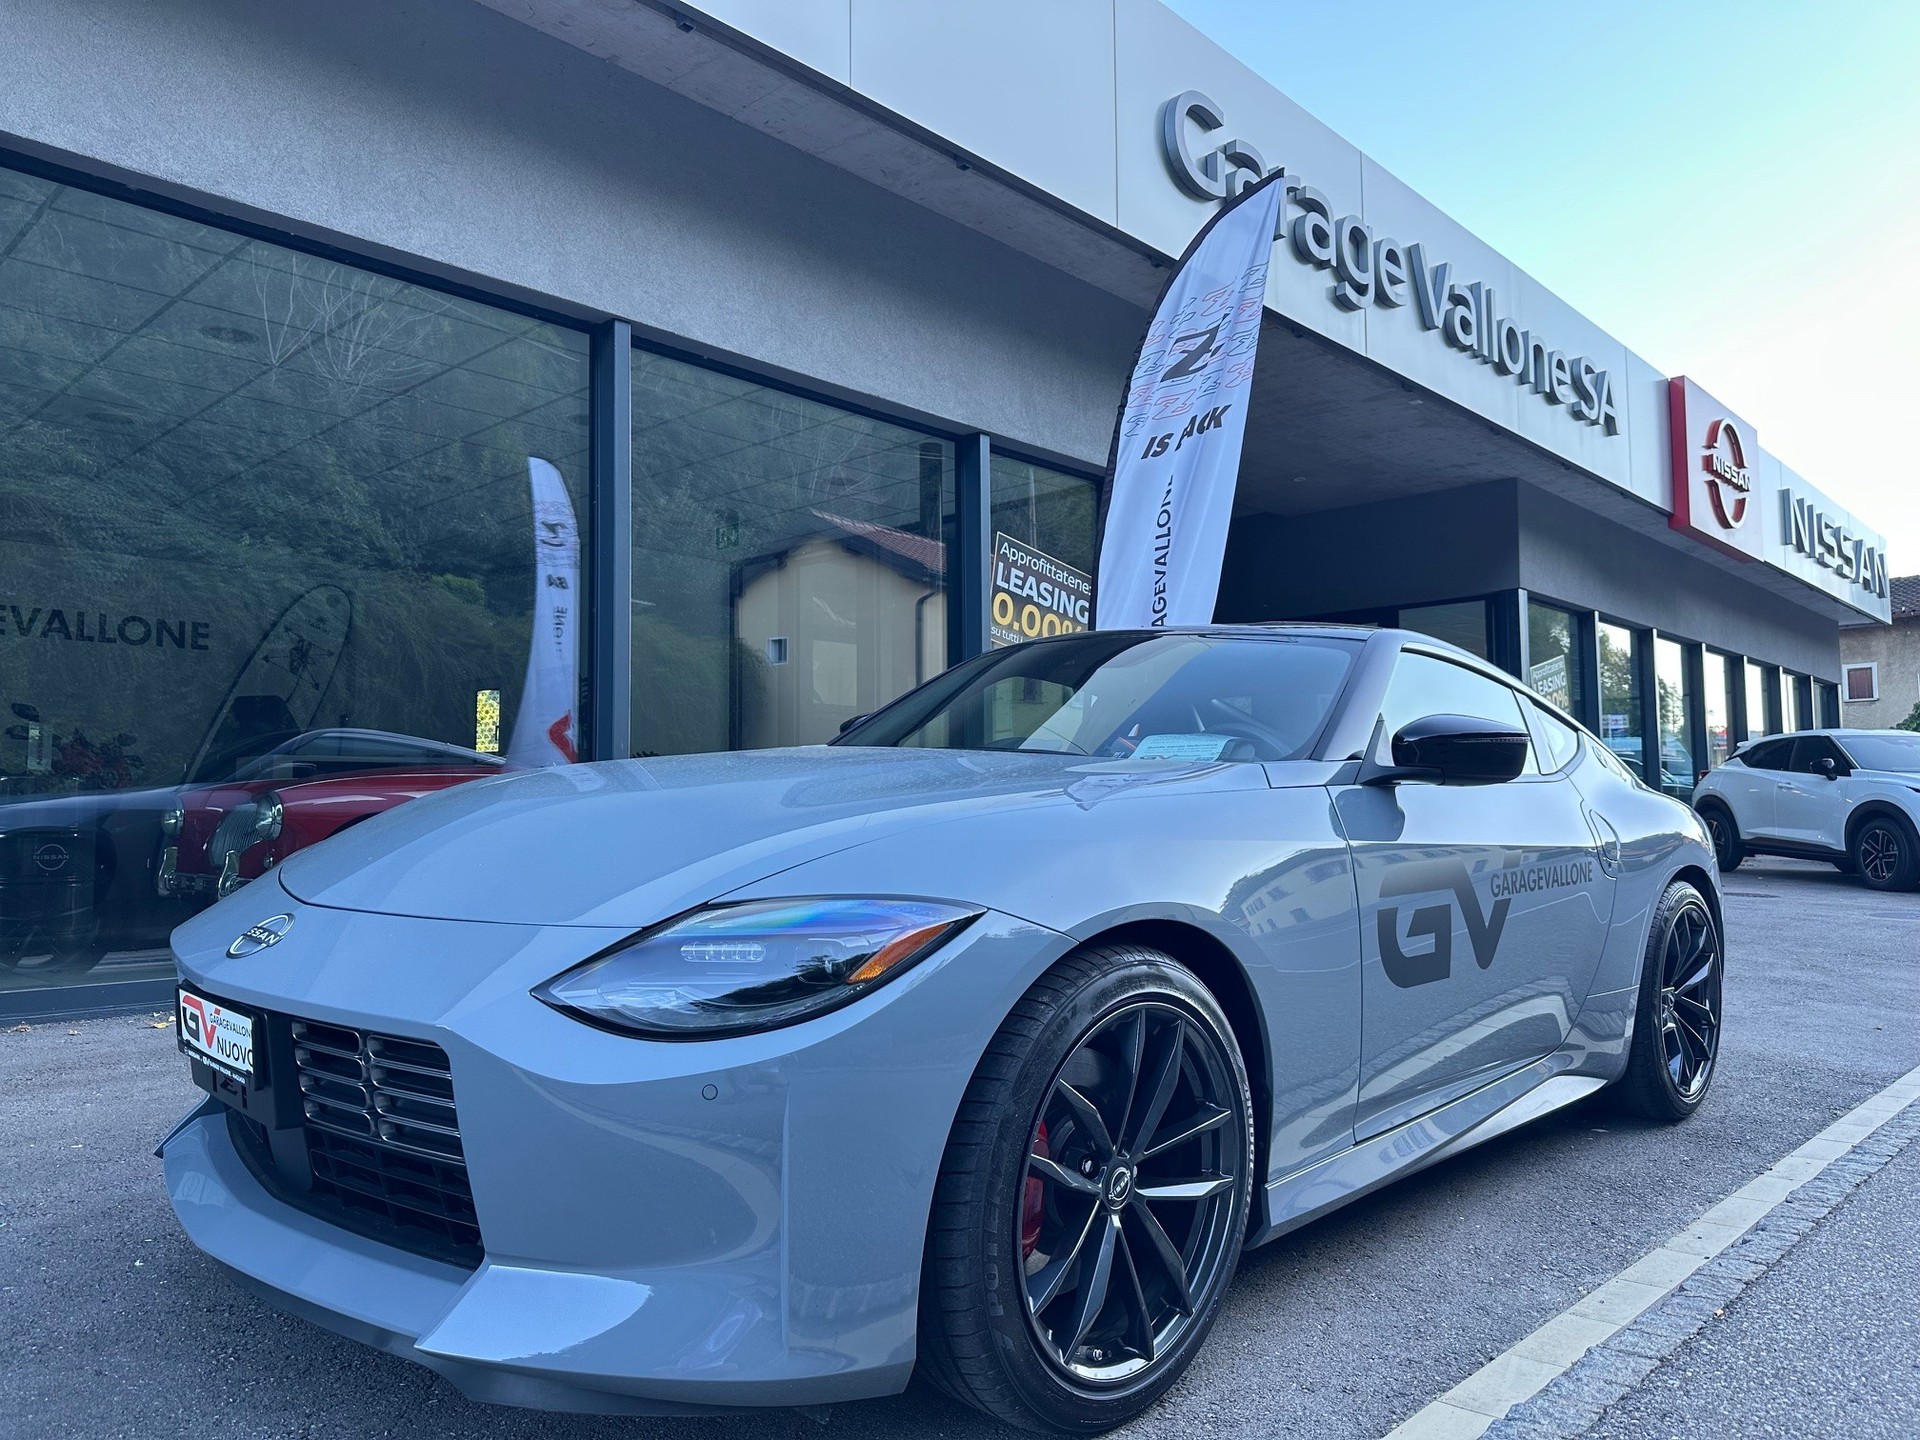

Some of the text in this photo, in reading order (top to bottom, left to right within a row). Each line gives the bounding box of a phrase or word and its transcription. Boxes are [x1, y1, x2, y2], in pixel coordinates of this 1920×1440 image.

[1140, 403, 1233, 460] IS ACK
[1711, 453, 1751, 492] NISSAN
[1779, 487, 1889, 599] NISSAN
[996, 561, 1090, 624] LEASING
[990, 626, 1001, 637] su
[33, 853, 70, 861] NISSAN
[1490, 861, 1594, 898] GARAGEVALLONE
[209, 1012, 252, 1038] GARAGEVALLON
